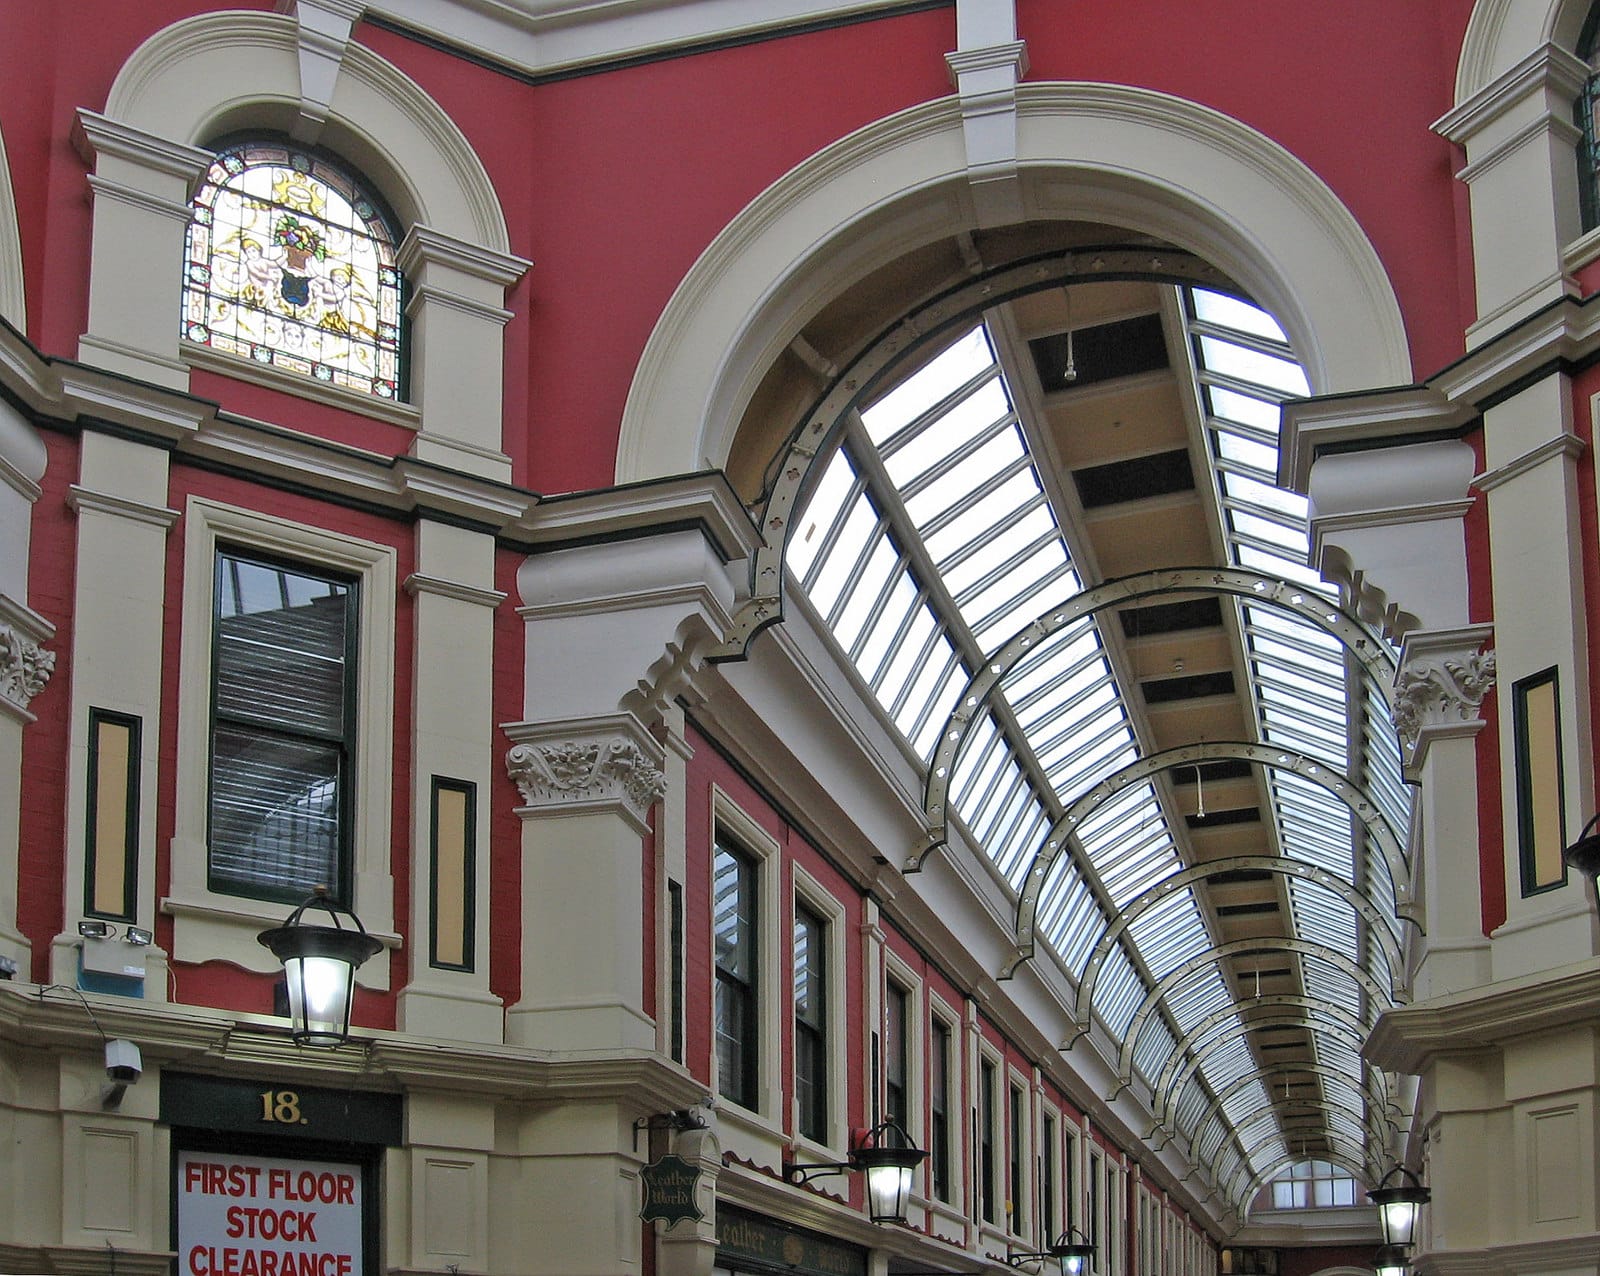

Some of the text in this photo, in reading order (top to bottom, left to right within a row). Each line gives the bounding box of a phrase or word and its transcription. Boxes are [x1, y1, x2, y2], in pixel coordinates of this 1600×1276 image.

[262, 1091, 308, 1124] 18.
[186, 1161, 354, 1205] FIRST FLOOR
[226, 1206, 317, 1243] STOCK
[718, 1219, 765, 1253] eather
[190, 1245, 352, 1276] CLEARANCE
